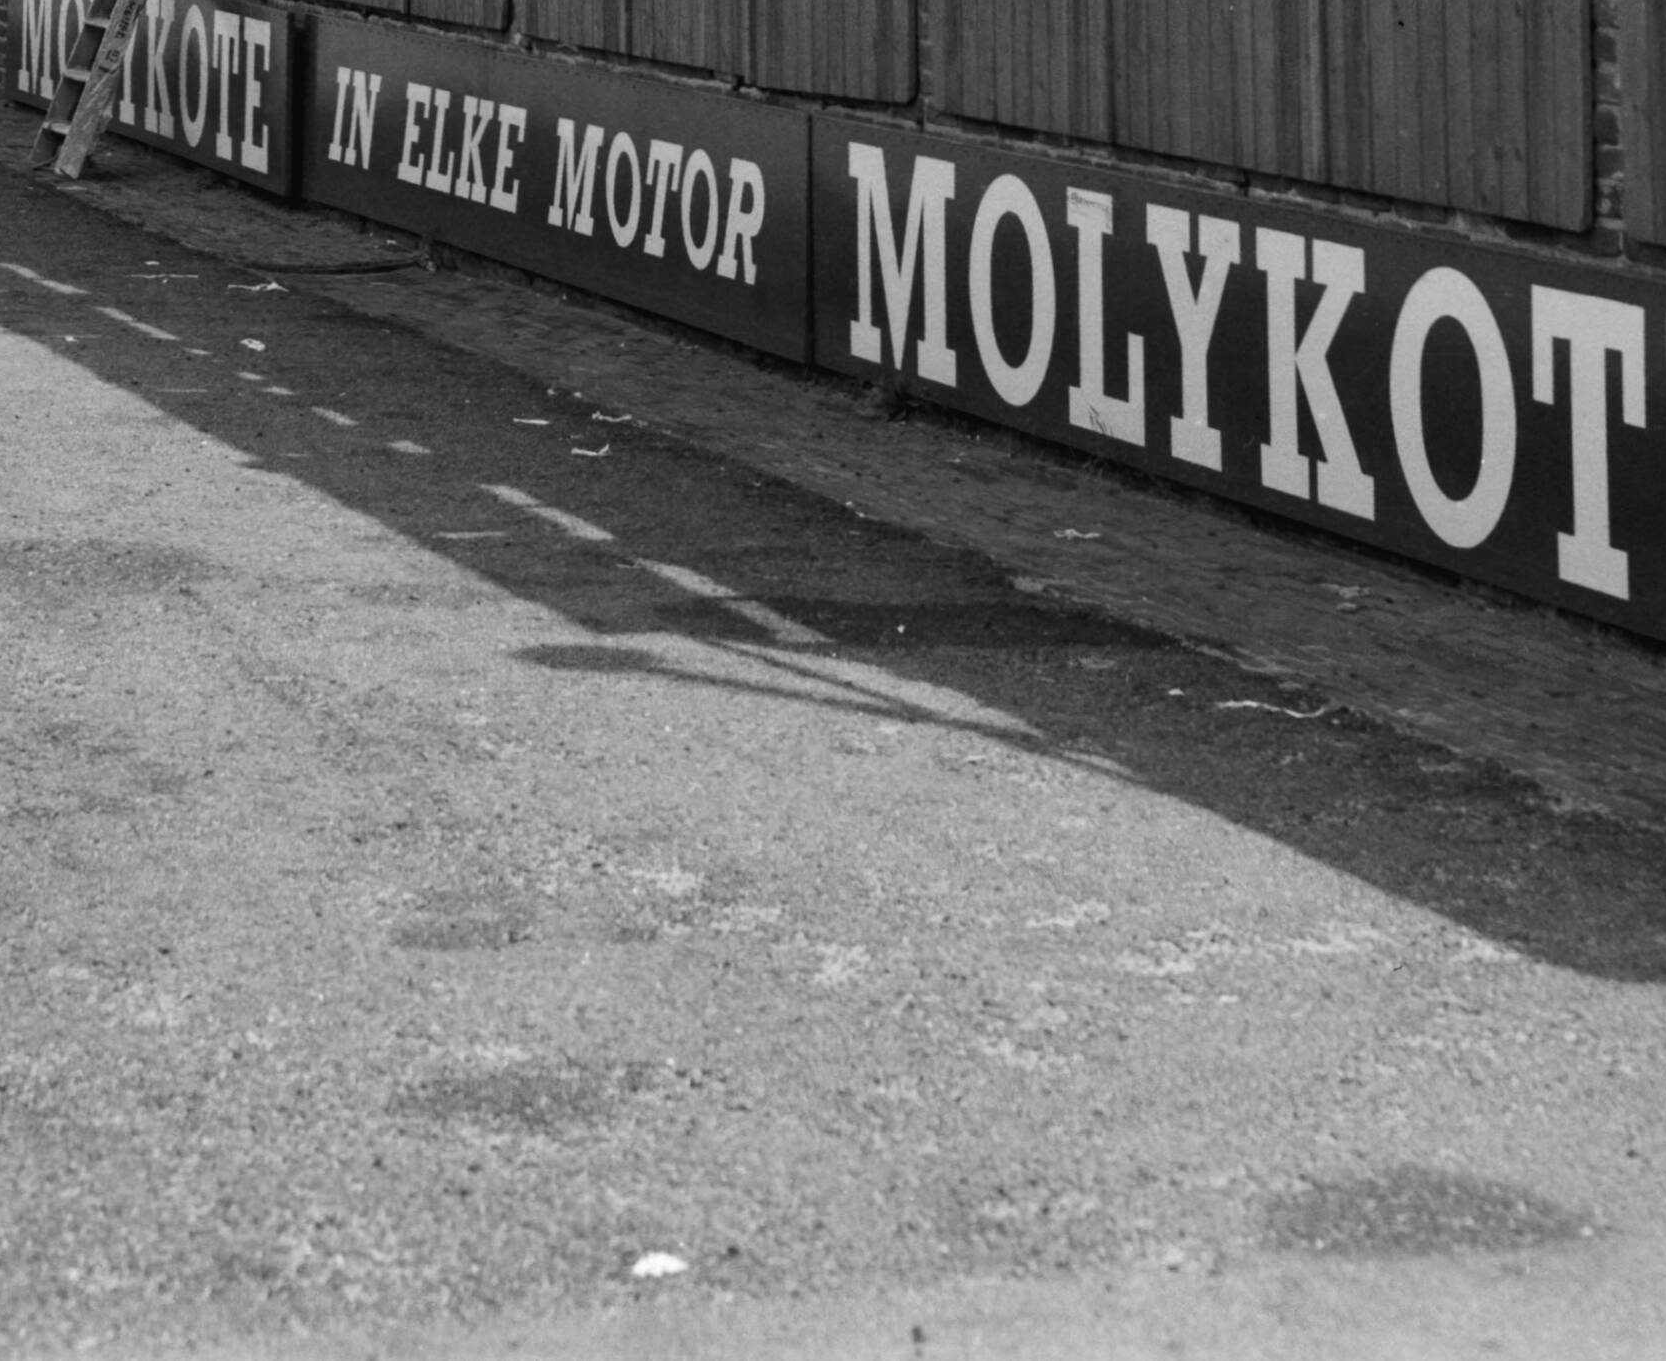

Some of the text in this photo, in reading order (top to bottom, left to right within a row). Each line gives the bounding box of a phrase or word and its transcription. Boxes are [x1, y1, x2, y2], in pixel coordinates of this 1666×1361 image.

[329, 66, 766, 285] IN ELKE MOTOR
